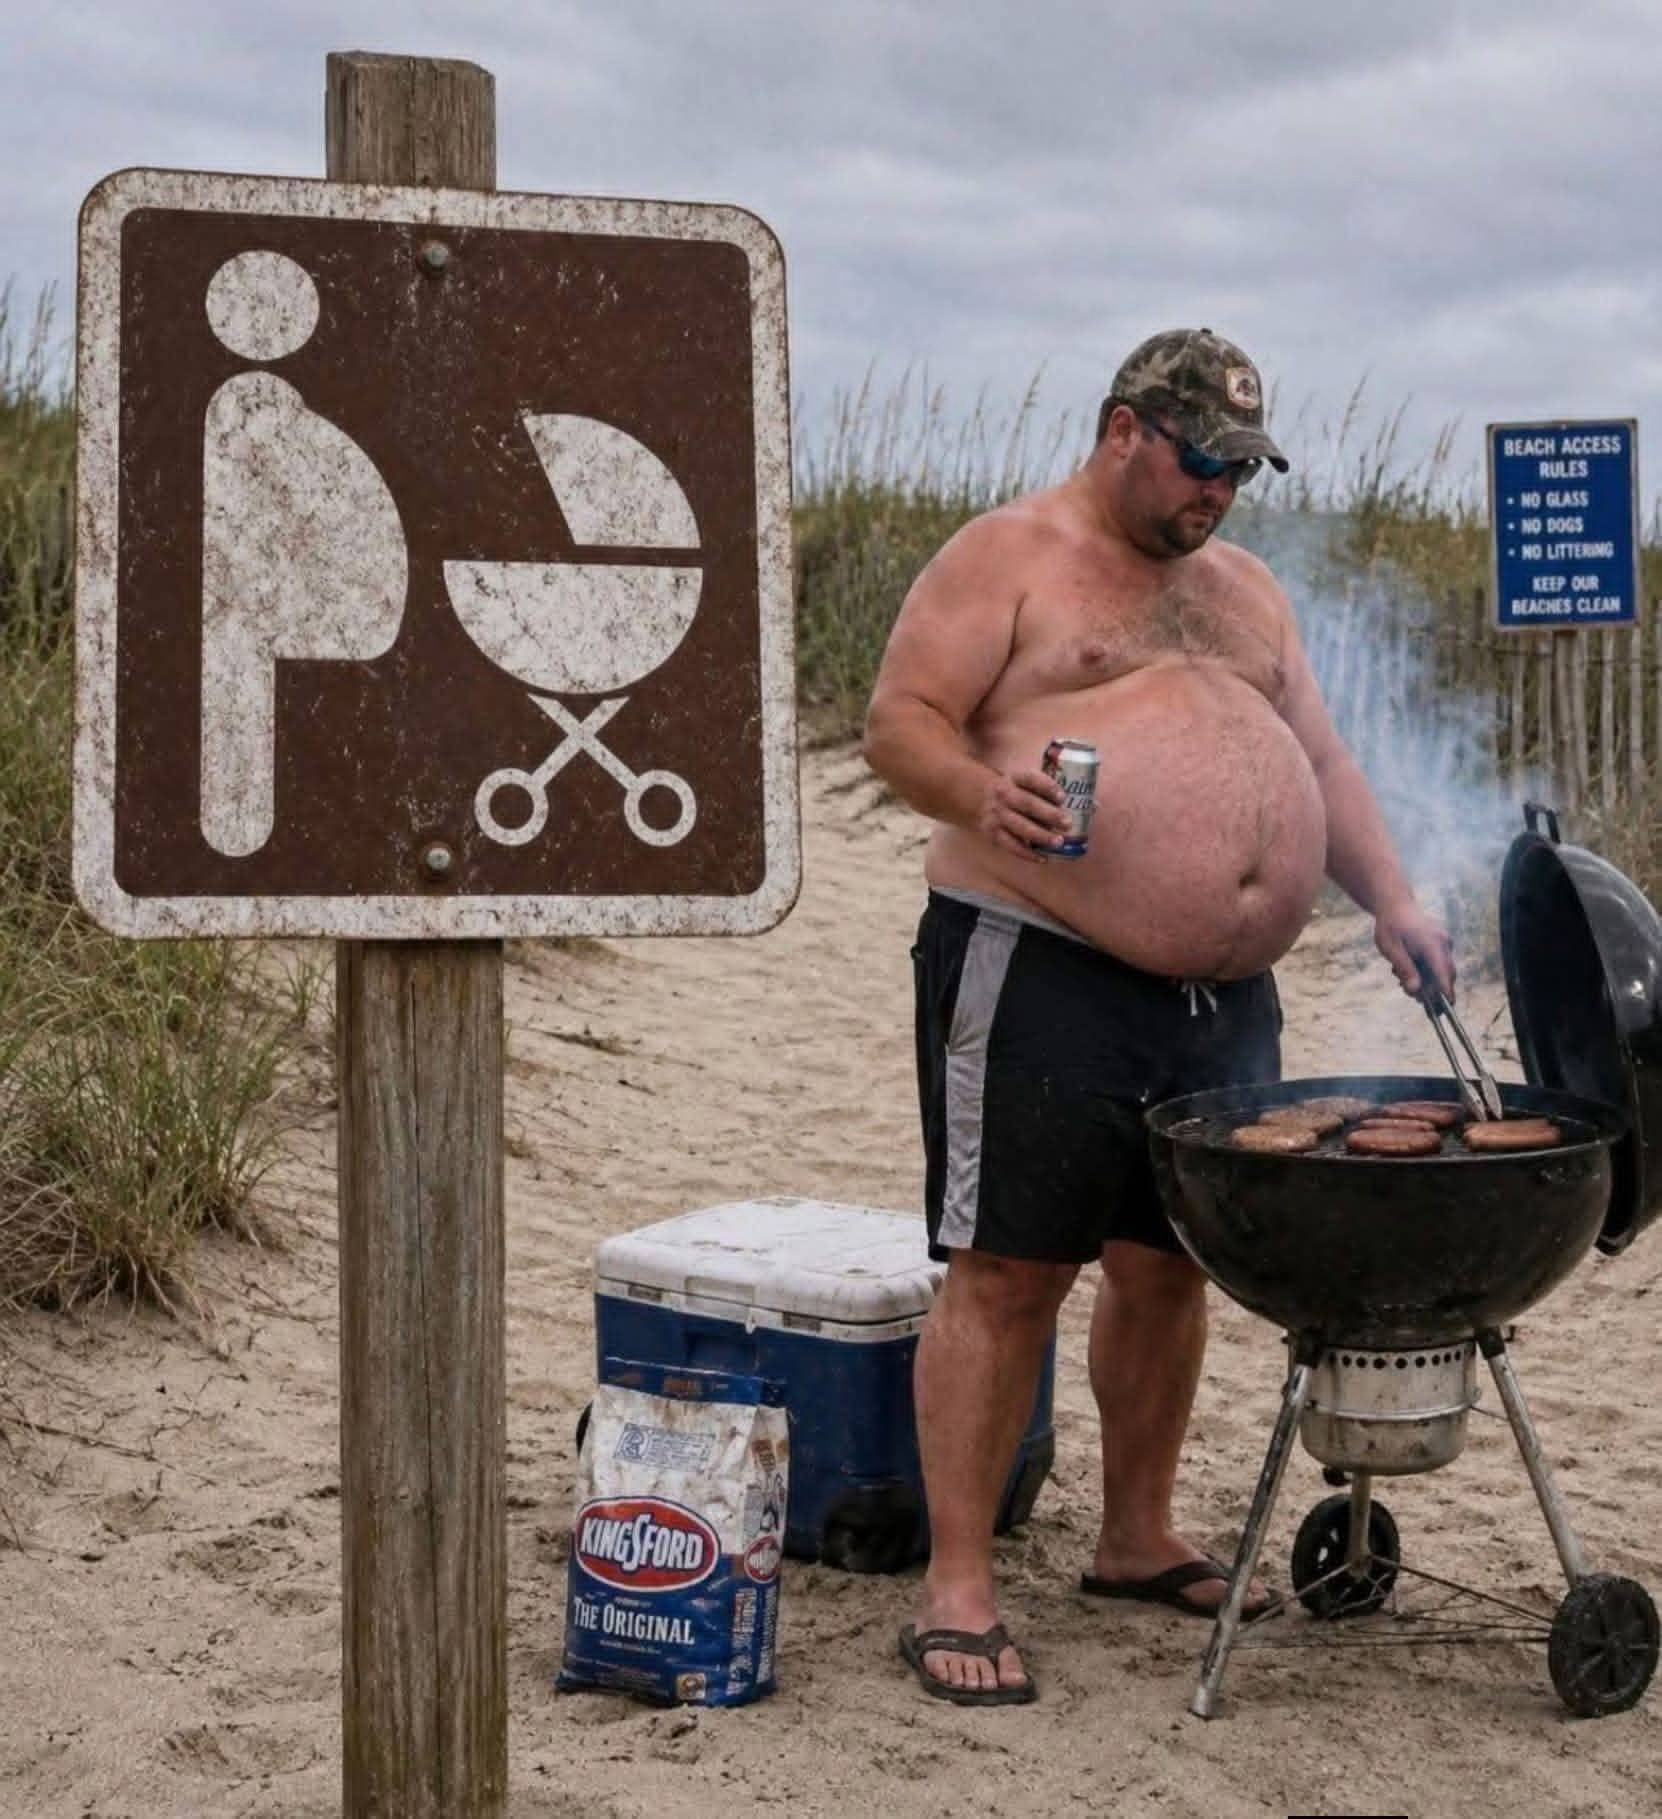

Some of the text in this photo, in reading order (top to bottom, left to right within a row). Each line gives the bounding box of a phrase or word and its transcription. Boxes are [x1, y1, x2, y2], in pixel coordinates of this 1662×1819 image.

[1505, 435, 1621, 456] BEACH ACCESS
[1540, 460, 1589, 478] RULES
[1521, 490, 1589, 508] NO GLASS
[1521, 517, 1584, 534] NO DOGS
[1522, 542, 1614, 560] NO LITTERING
[1533, 575, 1599, 592] KEEP OUR
[1512, 597, 1621, 615] BEACHES CLEAN
[580, 1514, 704, 1572] KINGSFORD
[573, 1597, 695, 1645] THE ORIGINAL
